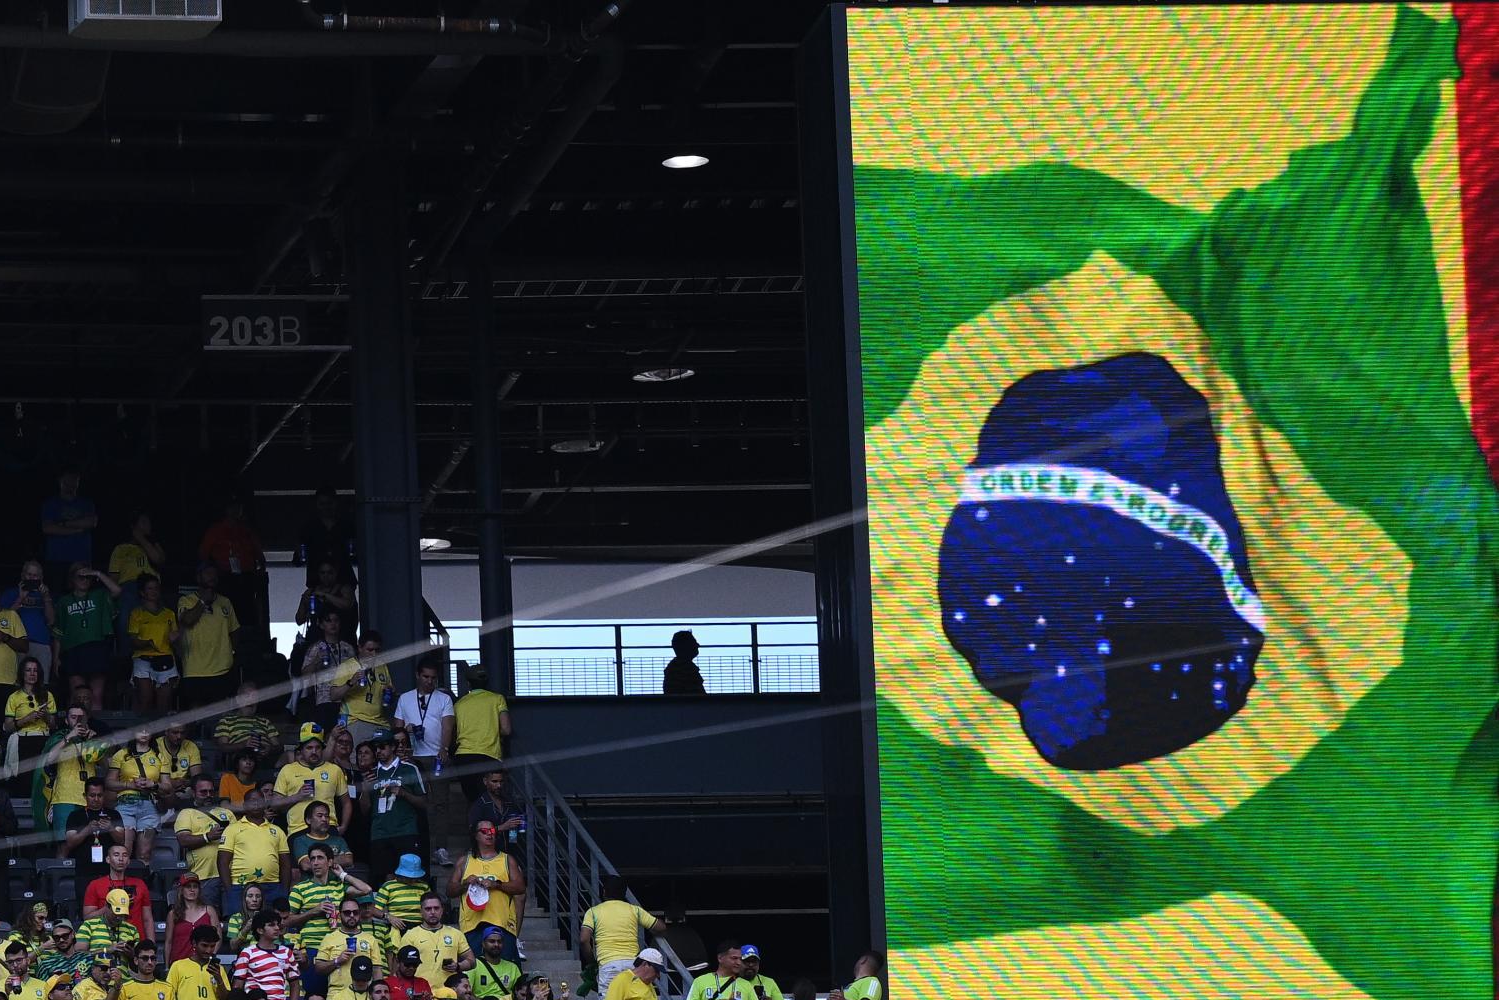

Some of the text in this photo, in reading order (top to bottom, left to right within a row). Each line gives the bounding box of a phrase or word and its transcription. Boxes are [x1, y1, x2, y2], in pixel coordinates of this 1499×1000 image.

[209, 315, 301, 346] 203B
[433, 949, 440, 963] 7
[197, 985, 208, 999] 10
